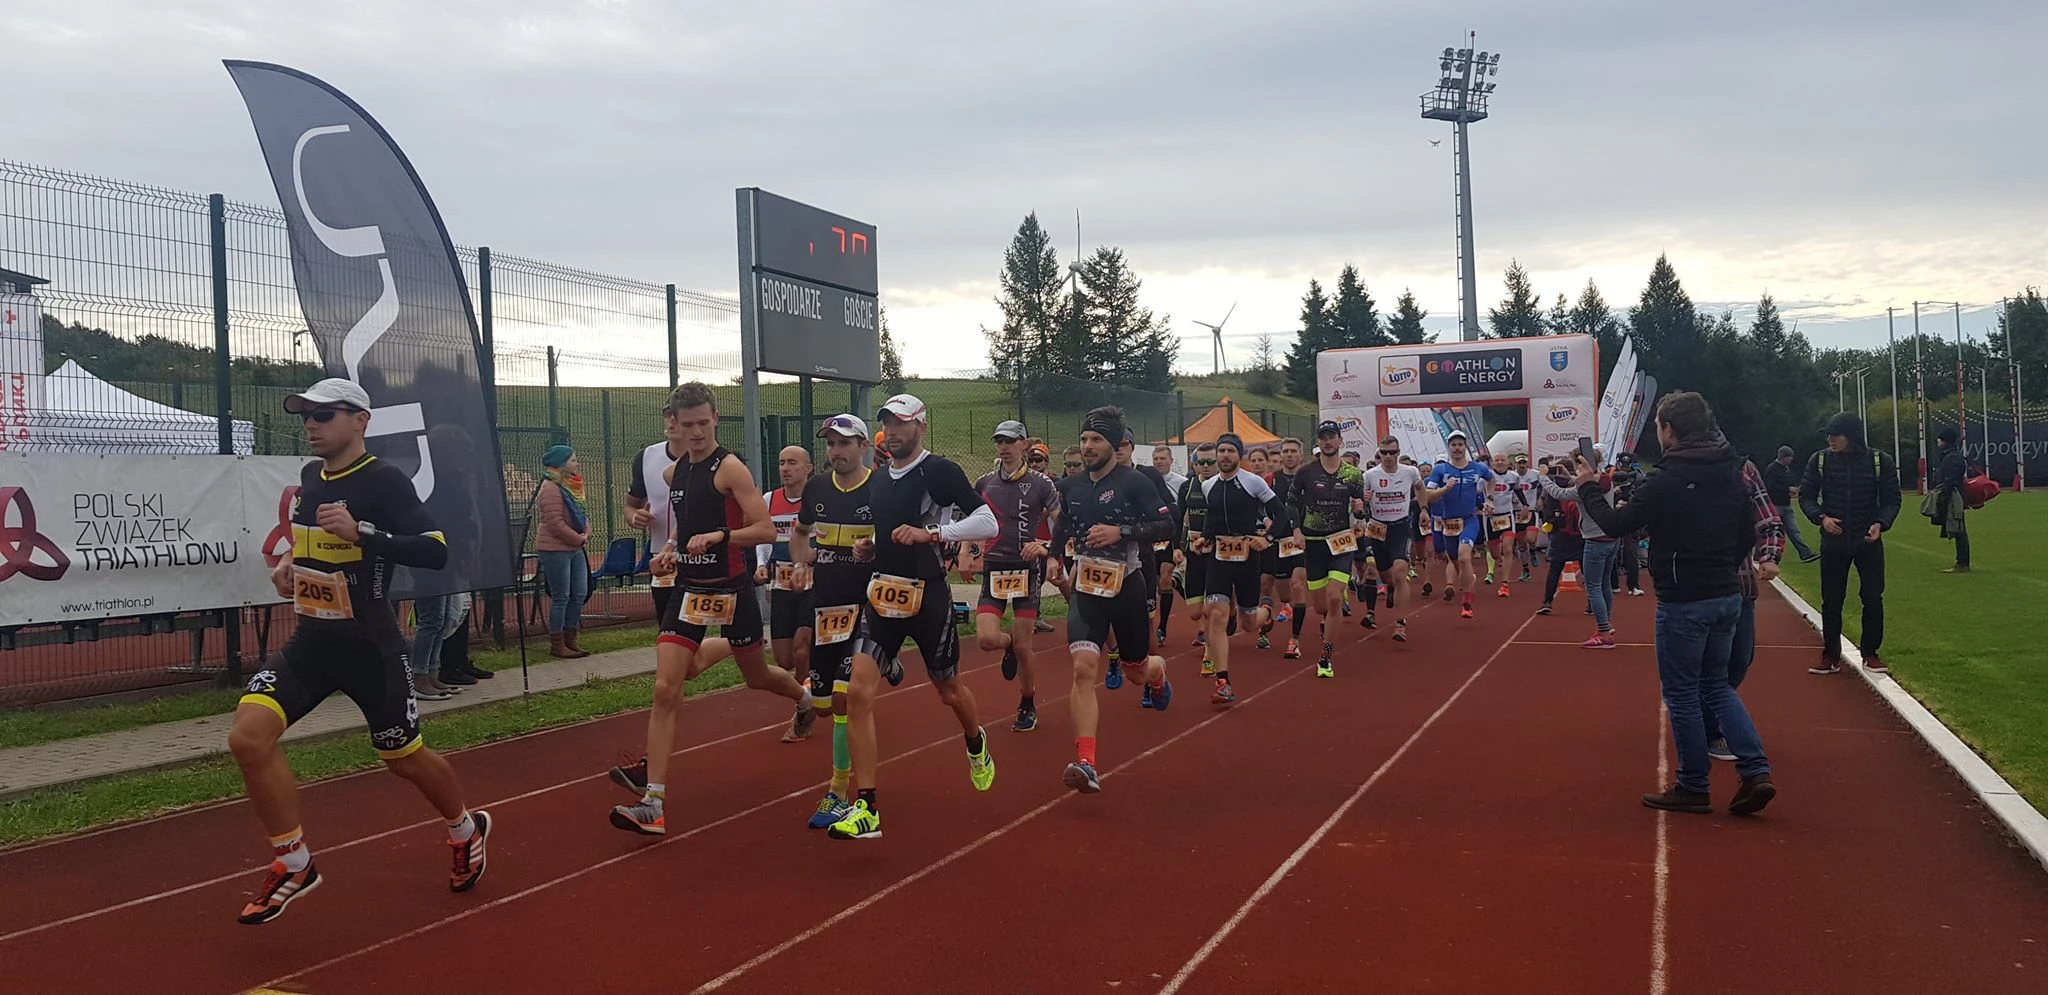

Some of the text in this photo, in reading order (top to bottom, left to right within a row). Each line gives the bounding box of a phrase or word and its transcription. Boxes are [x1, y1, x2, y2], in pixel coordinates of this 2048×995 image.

[761, 277, 822, 320] GOSPODARZE
[844, 294, 874, 330] GOŚCIE
[1388, 371, 1411, 383] LOTTO
[1459, 371, 1516, 384] ENERGY
[1551, 409, 1572, 420] LOTTO
[74, 493, 164, 518] POLSKI
[75, 518, 195, 546] ZWIĄZEK
[1220, 542, 1243, 552] 214
[1332, 535, 1351, 546] 100
[75, 541, 238, 572] TRIATHLONU
[677, 552, 718, 564] ATEUSZ
[1084, 568, 1112, 584] 157
[299, 580, 334, 602] 205
[996, 578, 1021, 590] 172
[875, 585, 909, 605] 105
[61, 596, 155, 613] www.triathlon.pl
[690, 597, 724, 612] 185
[821, 616, 849, 630] 119
